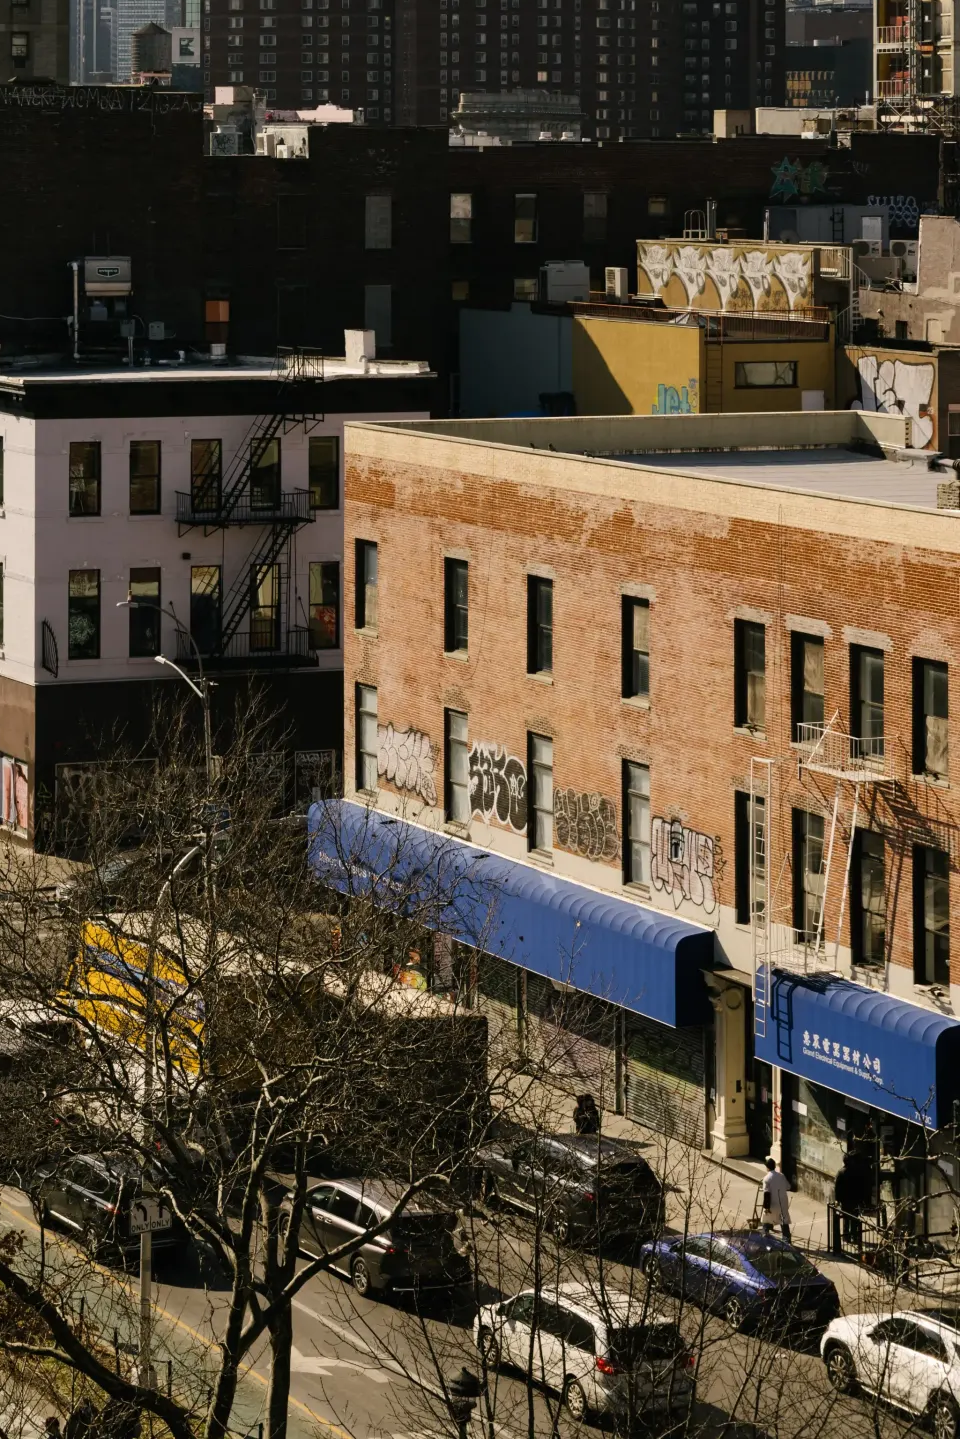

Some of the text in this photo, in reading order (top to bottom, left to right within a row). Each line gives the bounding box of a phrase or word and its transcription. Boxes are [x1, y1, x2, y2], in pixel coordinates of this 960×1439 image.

[802, 1046, 815, 1058] Grand
[815, 1051, 833, 1065] Electrical
[833, 1058, 854, 1073] Equipment
[858, 1068, 872, 1082] Supply
[132, 1223, 149, 1232] ONLY
[152, 1219, 169, 1228] ONLY
